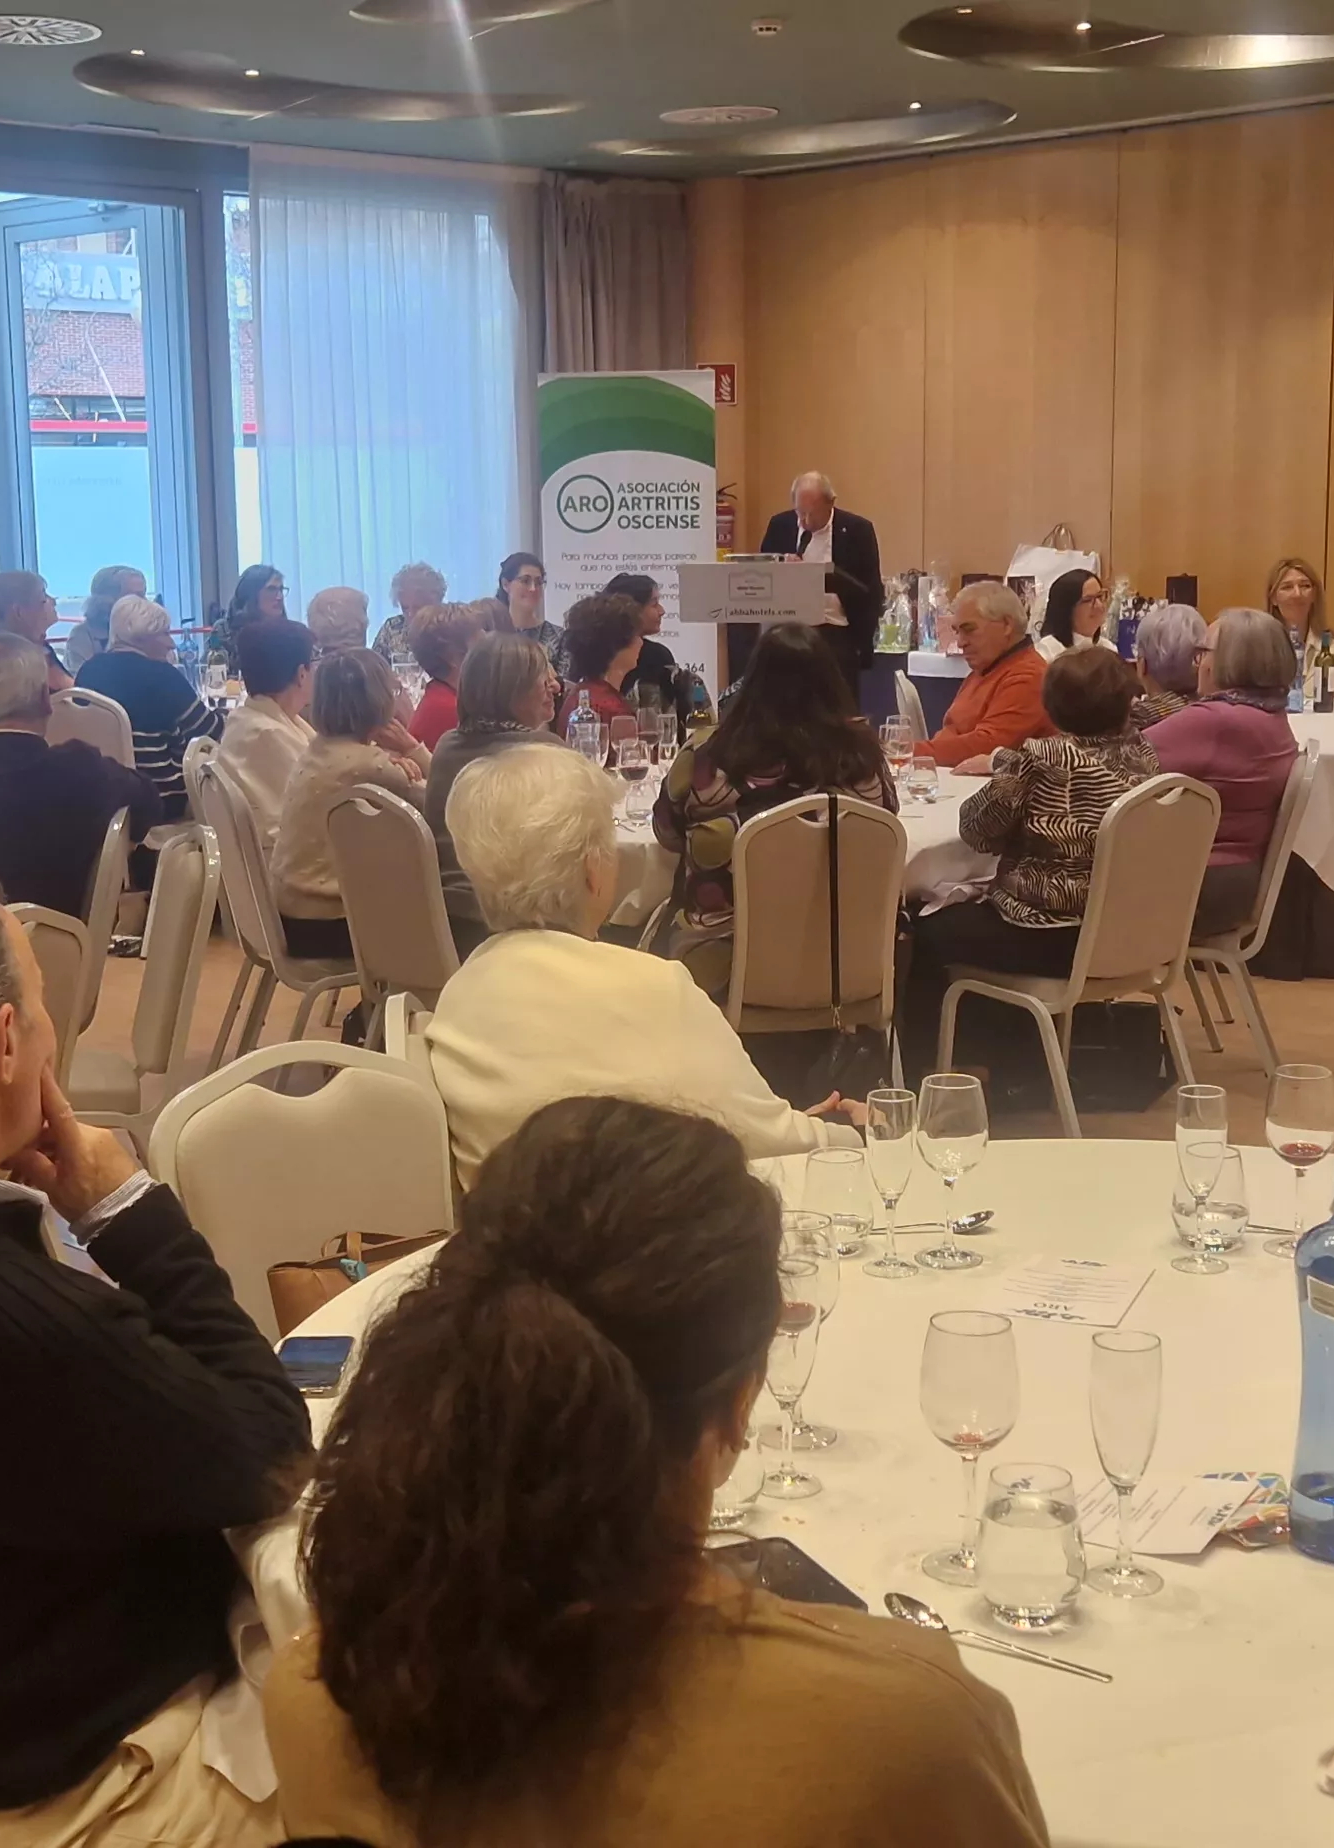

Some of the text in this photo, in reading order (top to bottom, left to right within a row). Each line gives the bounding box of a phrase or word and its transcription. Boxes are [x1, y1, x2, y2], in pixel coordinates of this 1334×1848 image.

[617, 480, 700, 494] ASOCIACIÓN
[563, 495, 609, 512] ARO
[617, 496, 700, 511] ARTRITIS
[617, 514, 700, 529] OSCENSE
[561, 551, 697, 562] Para muchas personas parece
[580, 563, 597, 572] que
[601, 563, 613, 571] no
